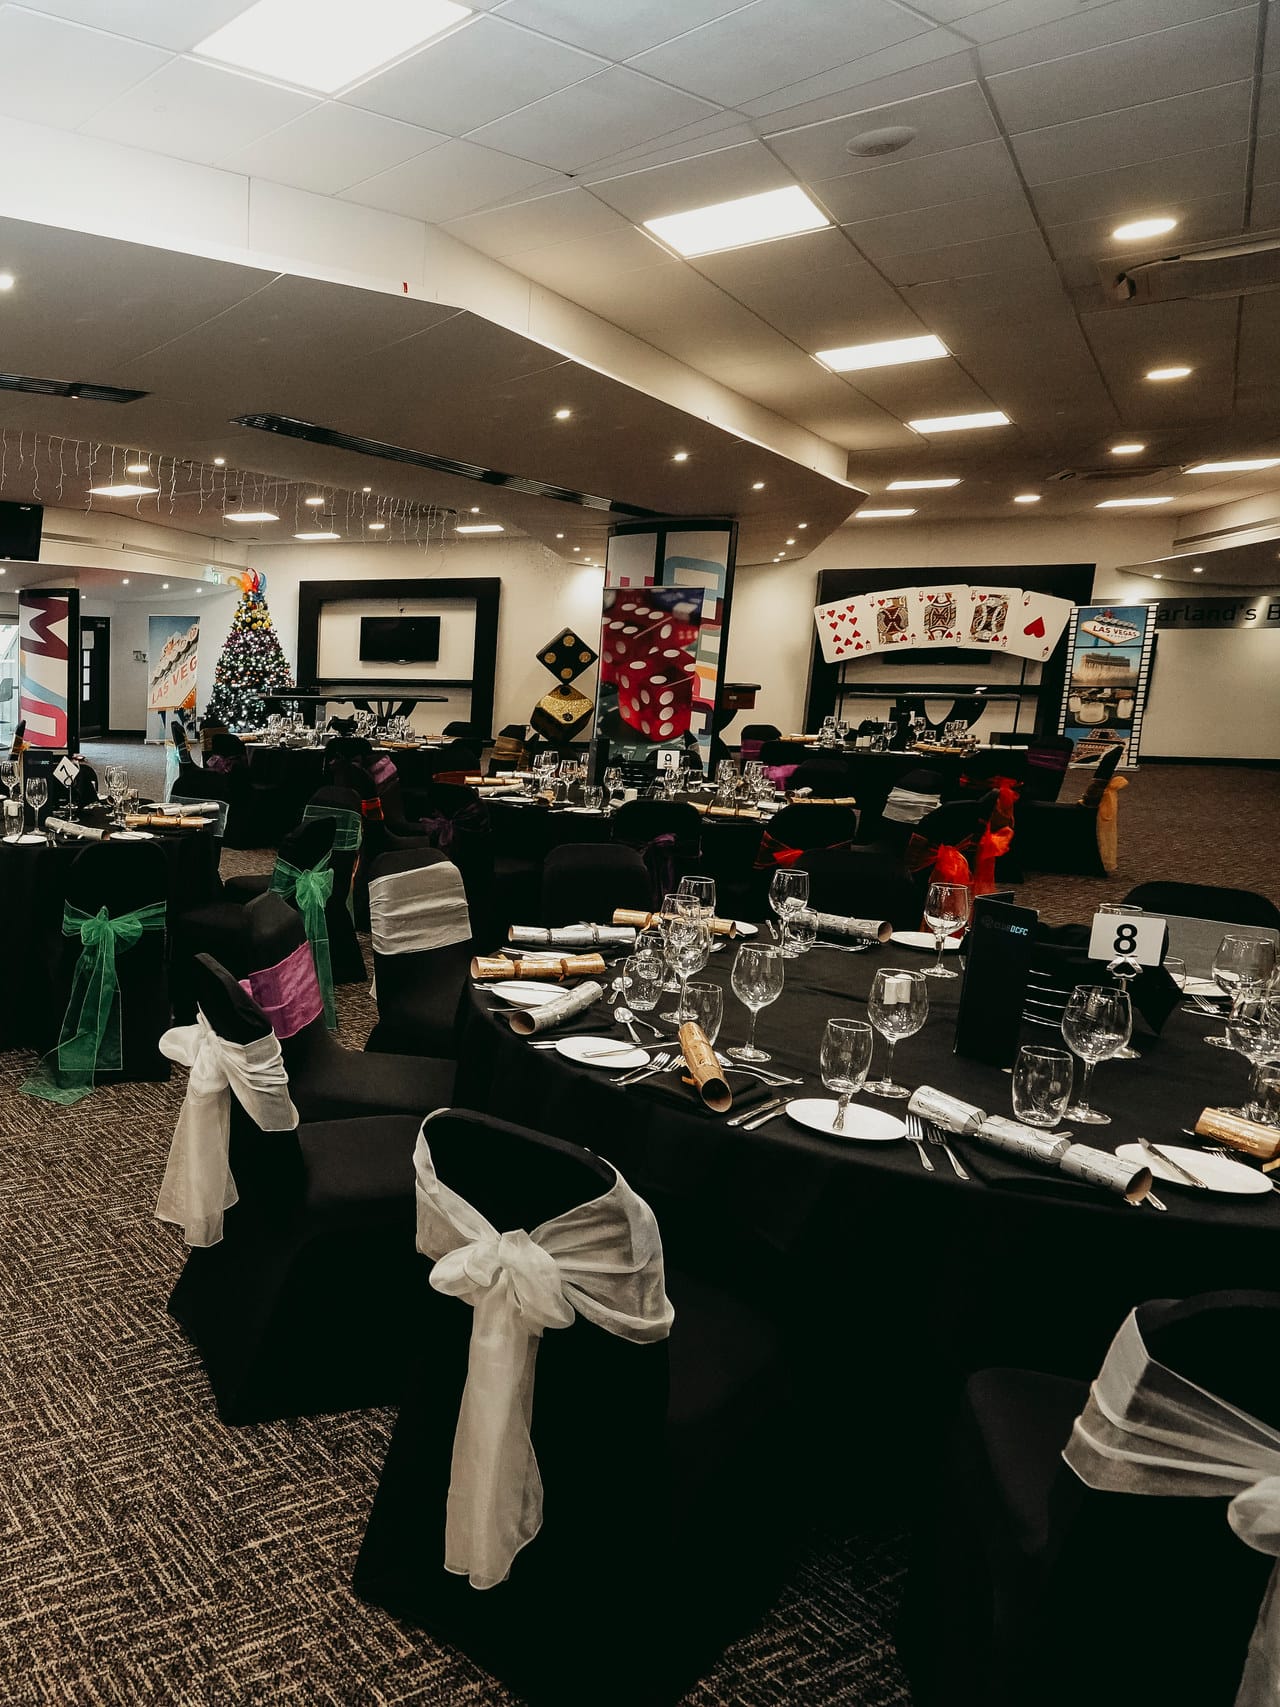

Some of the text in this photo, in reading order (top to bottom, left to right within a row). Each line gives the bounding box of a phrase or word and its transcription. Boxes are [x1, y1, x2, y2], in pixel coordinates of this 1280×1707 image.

[1157, 604, 1257, 621] arland's
[1093, 626, 1111, 634] LAS
[1114, 628, 1137, 637] VEGAS
[151, 681, 169, 705] LAS
[356, 711, 365, 721] 12
[1113, 923, 1138, 954] 8
